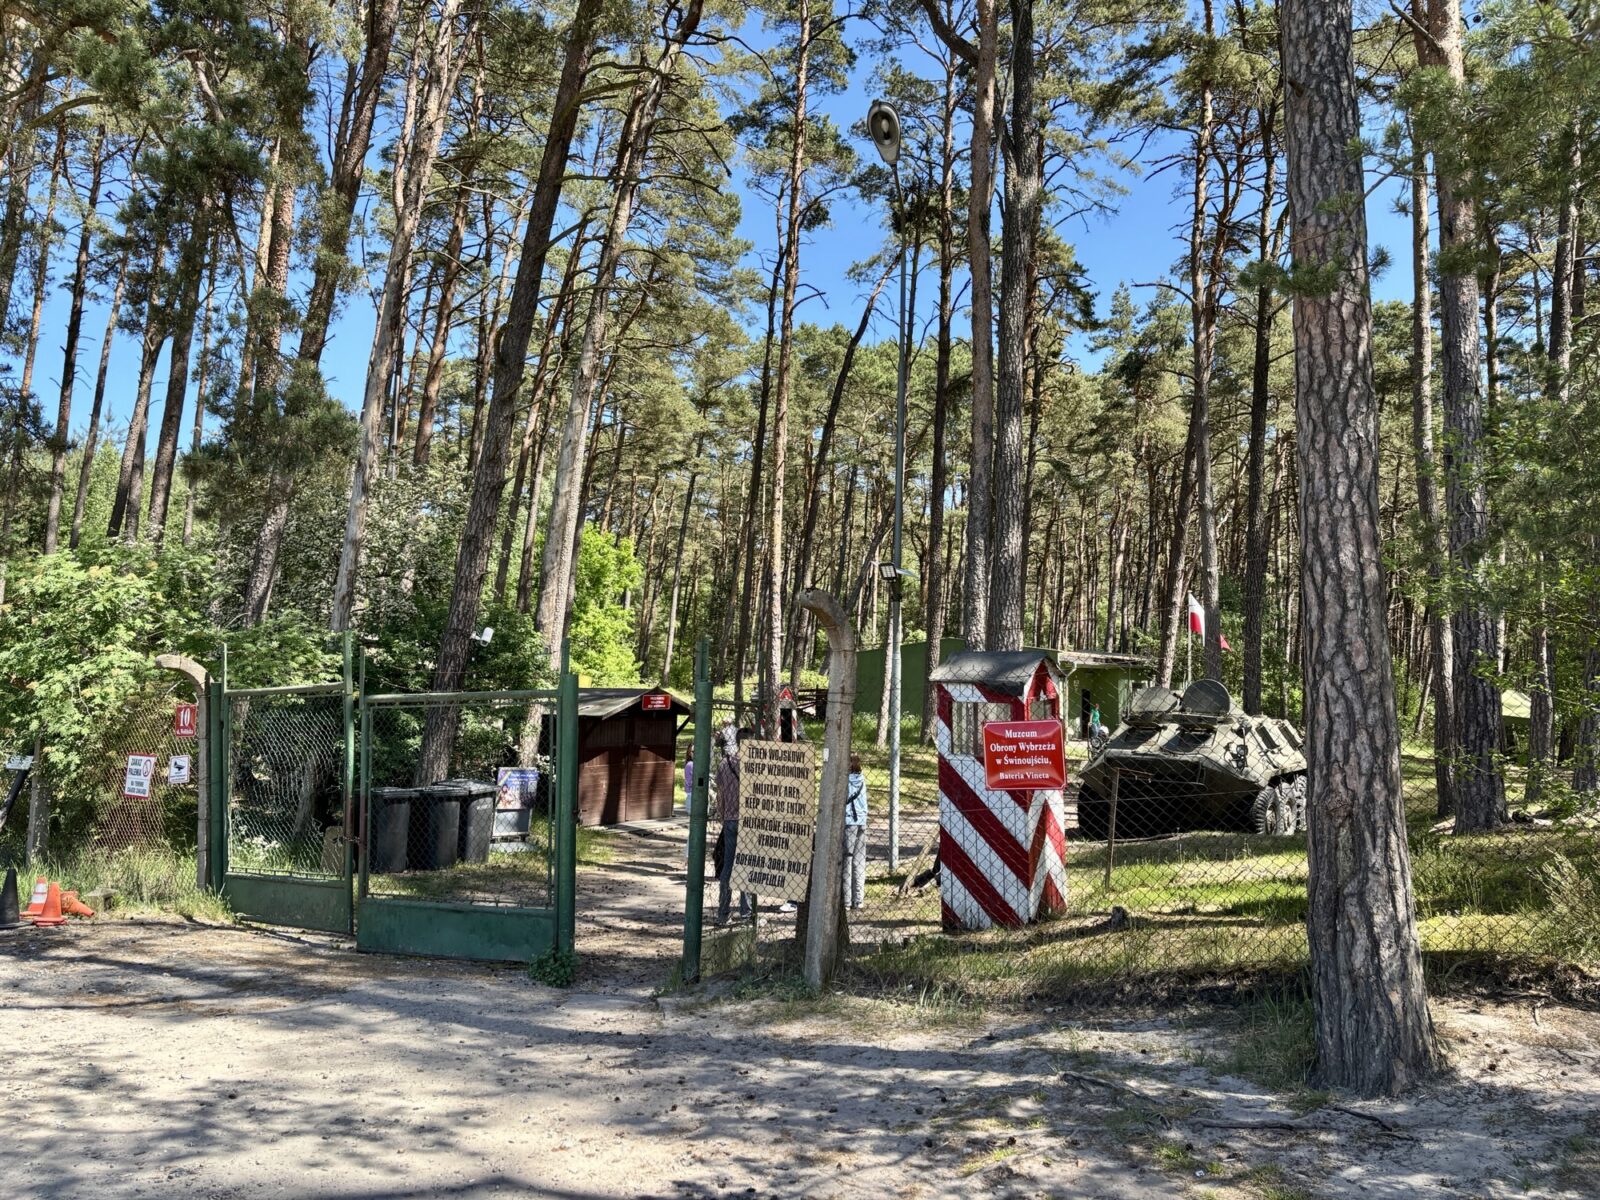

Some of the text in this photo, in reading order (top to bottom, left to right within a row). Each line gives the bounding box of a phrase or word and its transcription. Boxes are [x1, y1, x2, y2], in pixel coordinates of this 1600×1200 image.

[180, 708, 191, 727] 10
[1005, 729, 1038, 738] Muzeum
[748, 747, 805, 763] TEREN WOJSKOWY
[990, 742, 1056, 753] Obrony Wybrzeża
[1004, 755, 1052, 766] Świnoujściu,
[744, 762, 809, 780] WSTĘP WZBRONIONY
[1026, 772, 1050, 780] Vineta
[753, 782, 800, 799] MILITARY AREA
[745, 797, 760, 809] KEEP
[786, 802, 807, 815] ENTRY
[782, 822, 810, 836] EINTRITT
[758, 834, 790, 850] VERBOTEN
